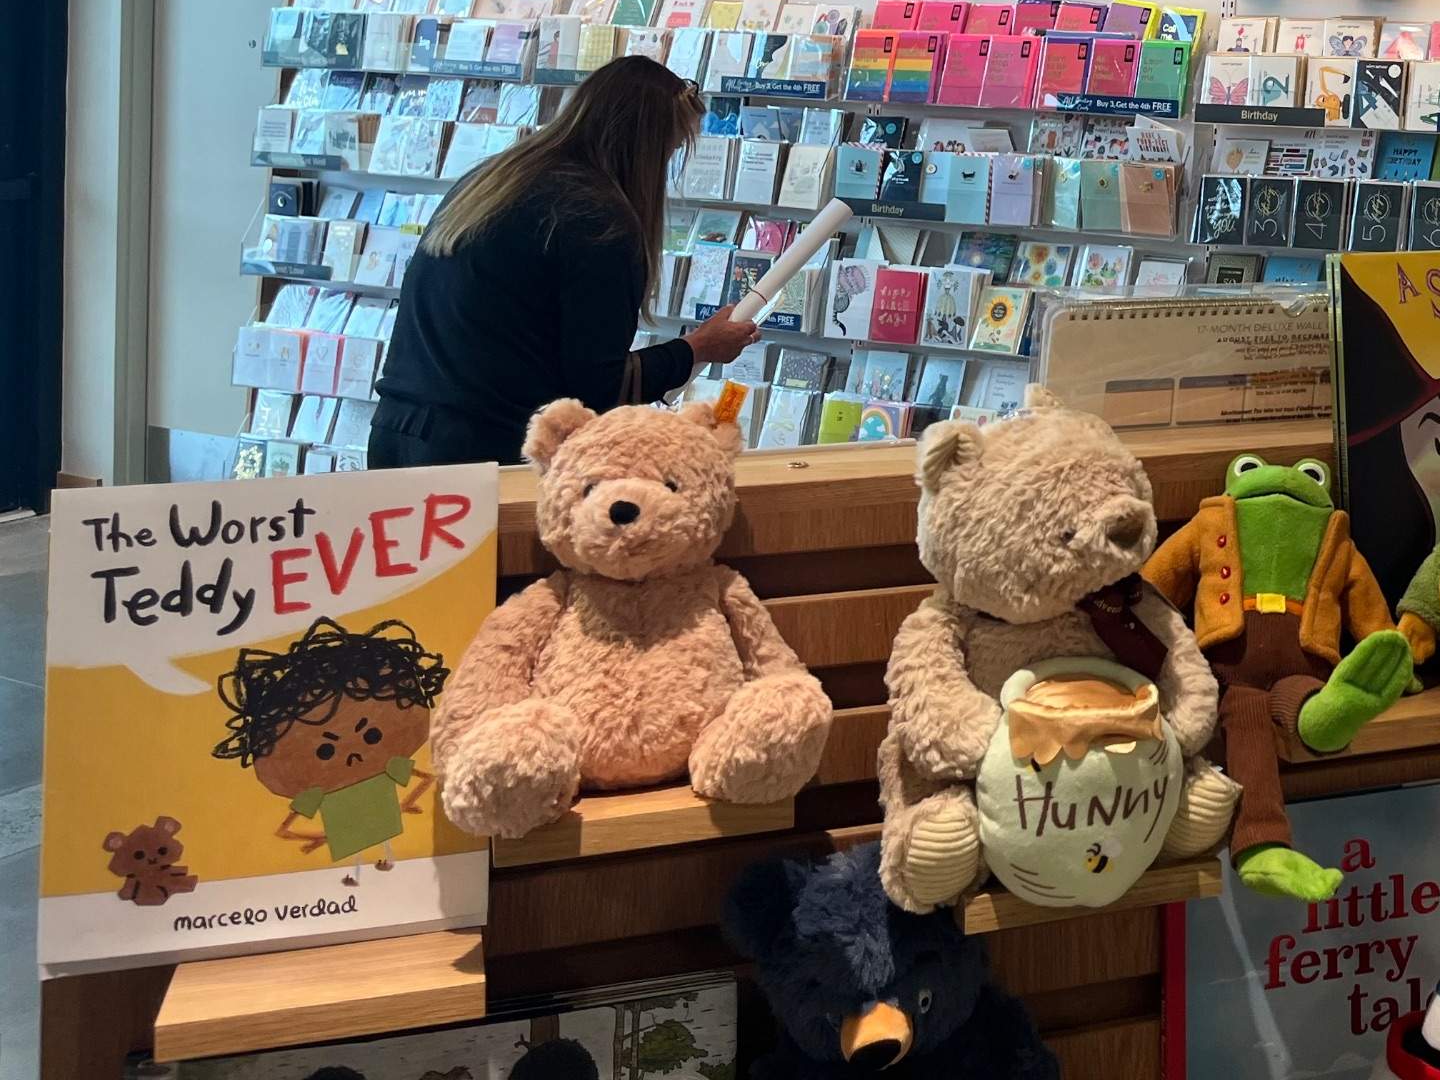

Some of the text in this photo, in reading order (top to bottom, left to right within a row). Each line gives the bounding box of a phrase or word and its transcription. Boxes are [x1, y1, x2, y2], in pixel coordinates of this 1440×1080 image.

[1096, 100, 1109, 110] Buy
[1116, 101, 1127, 109] Get
[1128, 101, 1139, 109] the
[1152, 102, 1172, 112] FREE
[1241, 109, 1279, 122] Birthday
[872, 204, 904, 216] Birthday
[1397, 262, 1422, 304] A
[778, 316, 795, 325] FREE
[1253, 321, 1322, 331] DELUXE WALL
[82, 497, 317, 553] The Worst
[91, 493, 472, 636] Teddy EVER
[1341, 837, 1376, 873] a
[173, 895, 359, 933] marcelo verdad
[1302, 874, 1440, 934] little
[1263, 933, 1419, 991] ferry
